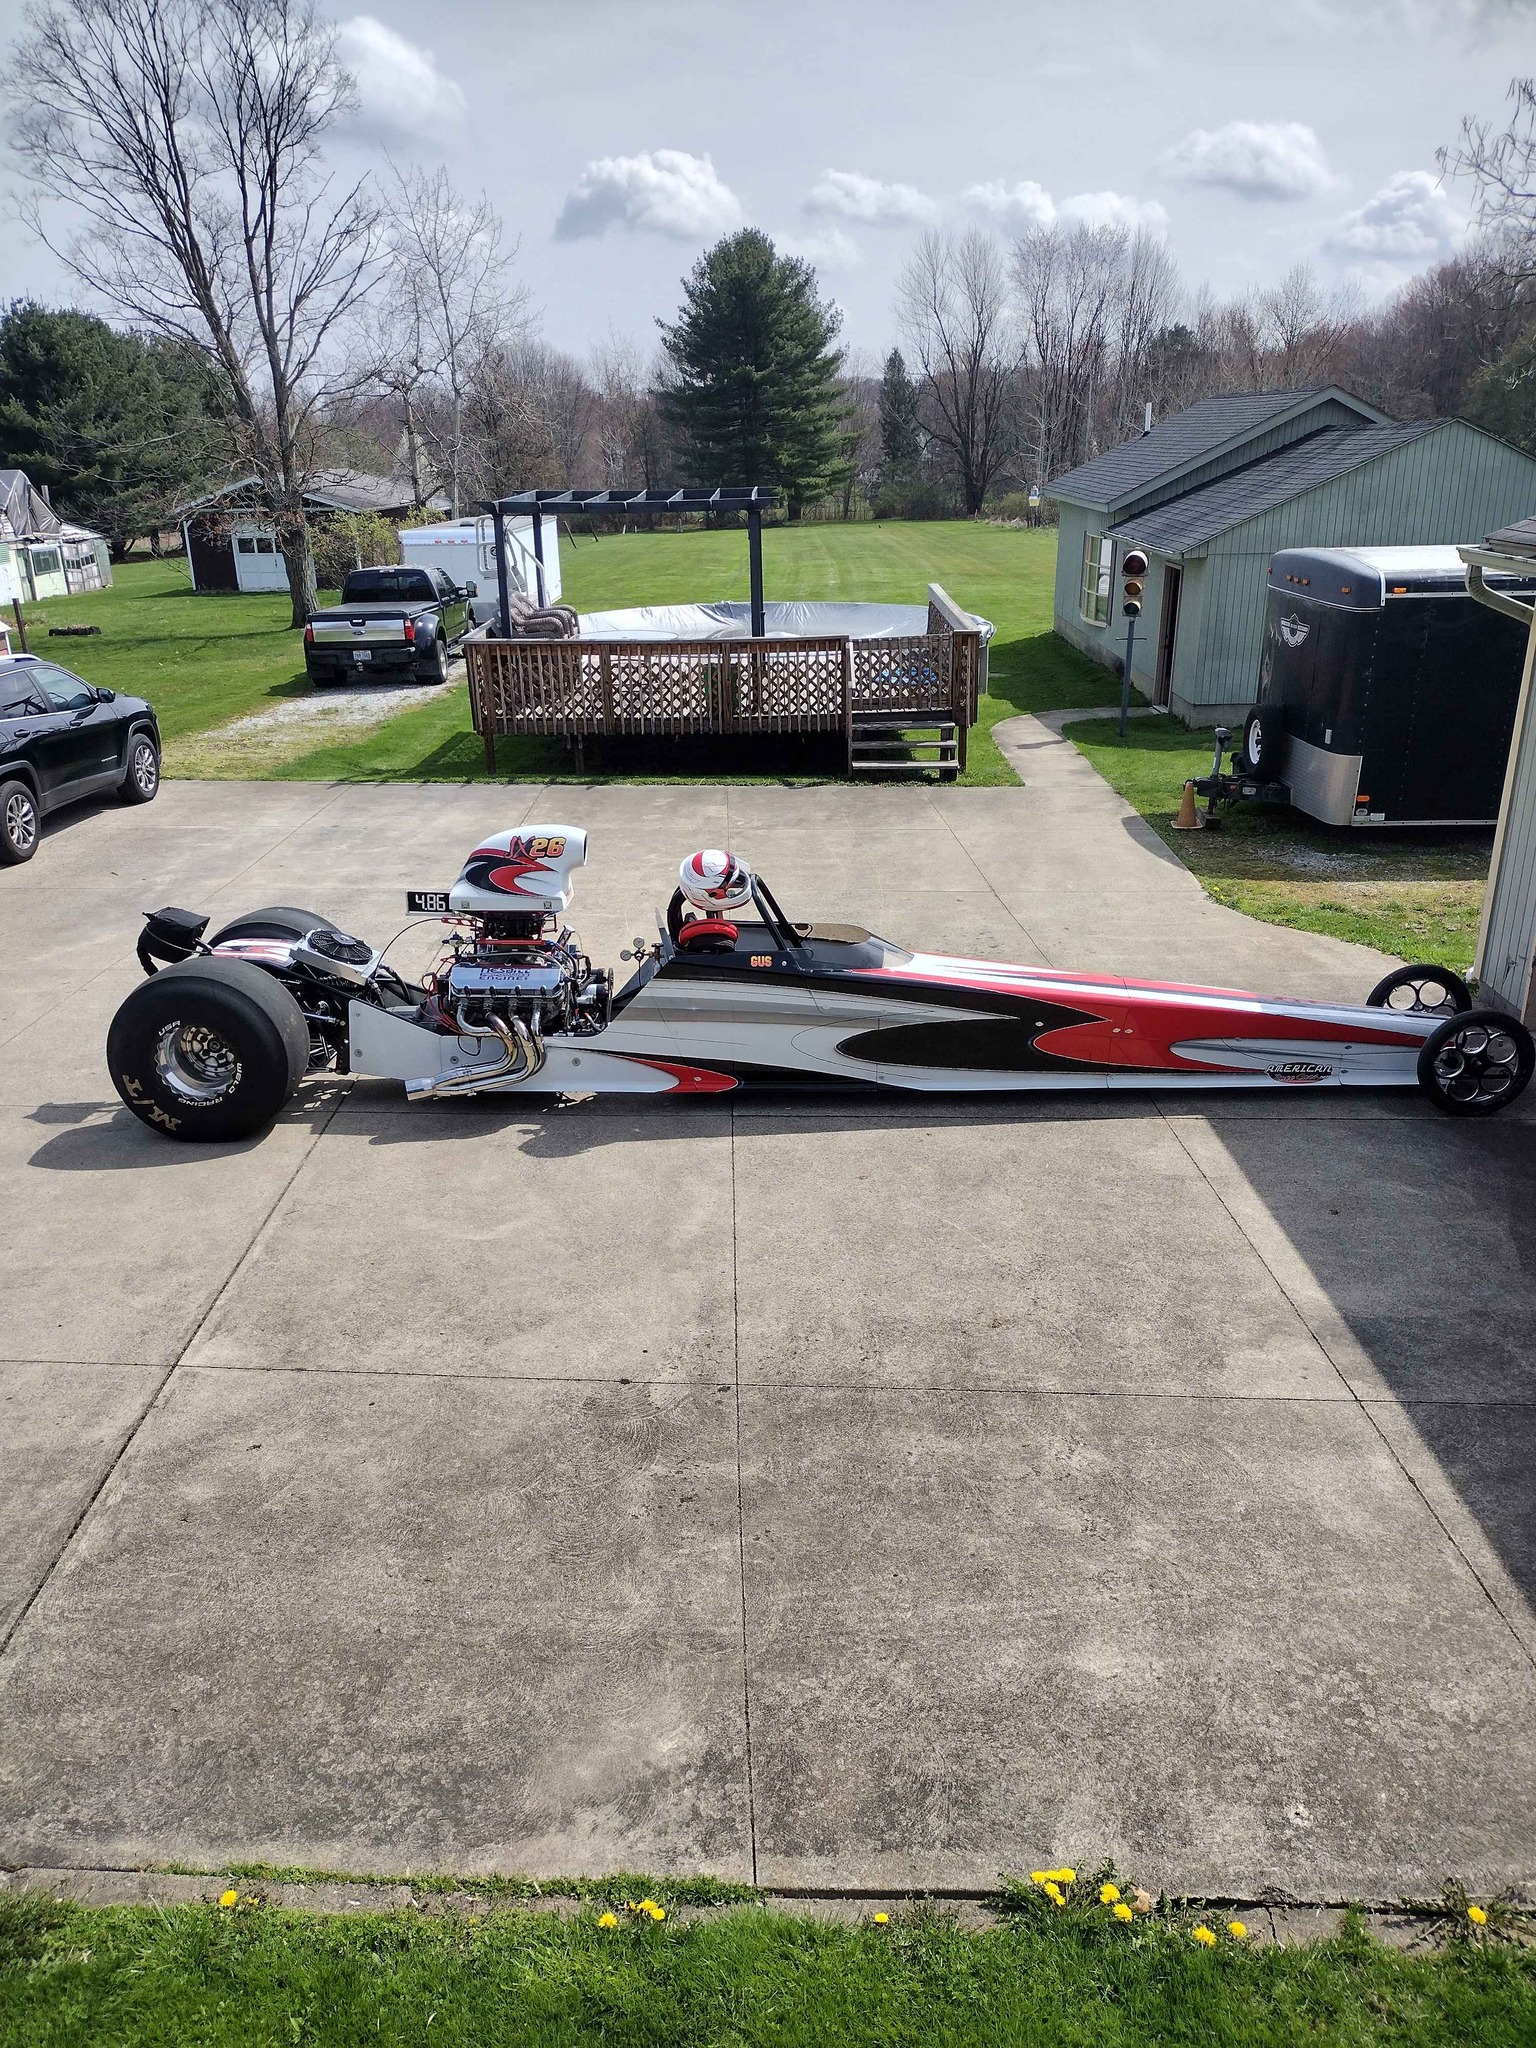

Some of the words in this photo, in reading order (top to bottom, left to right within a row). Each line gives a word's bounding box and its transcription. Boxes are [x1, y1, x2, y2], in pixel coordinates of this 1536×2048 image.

[415, 893, 447, 912] 4.86
[750, 955, 773, 968] GUS
[158, 1020, 181, 1037] USA
[1266, 1064, 1332, 1073] AMERICAN
[228, 1062, 243, 1094] WELD
[177, 1096, 223, 1107] RACING
